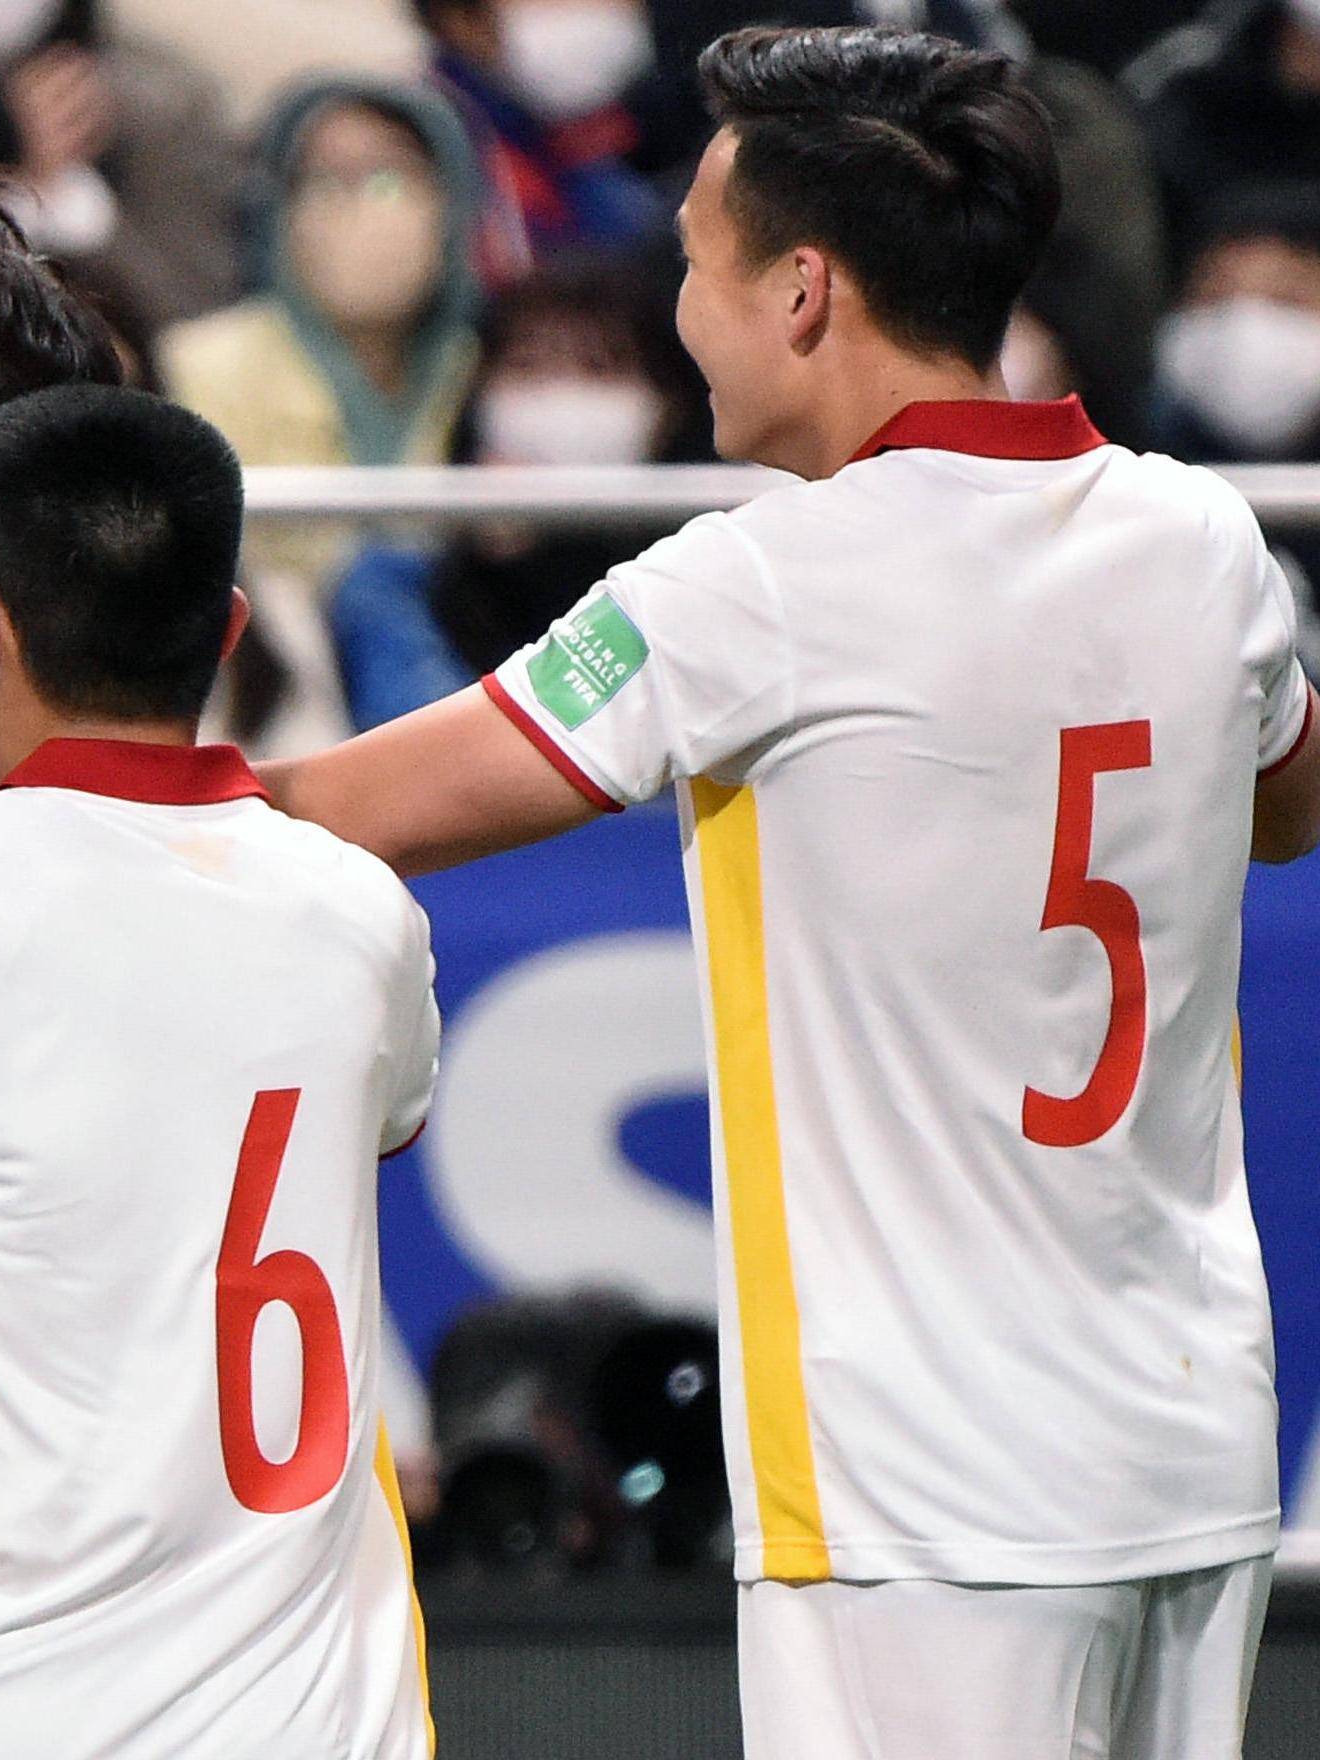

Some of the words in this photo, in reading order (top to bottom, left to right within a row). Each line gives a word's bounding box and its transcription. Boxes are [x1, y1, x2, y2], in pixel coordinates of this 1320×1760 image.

[556, 626, 614, 686] OTBALL
[563, 668, 601, 706] FIFA
[1022, 719, 1151, 1148] 5
[216, 1087, 349, 1514] 6
